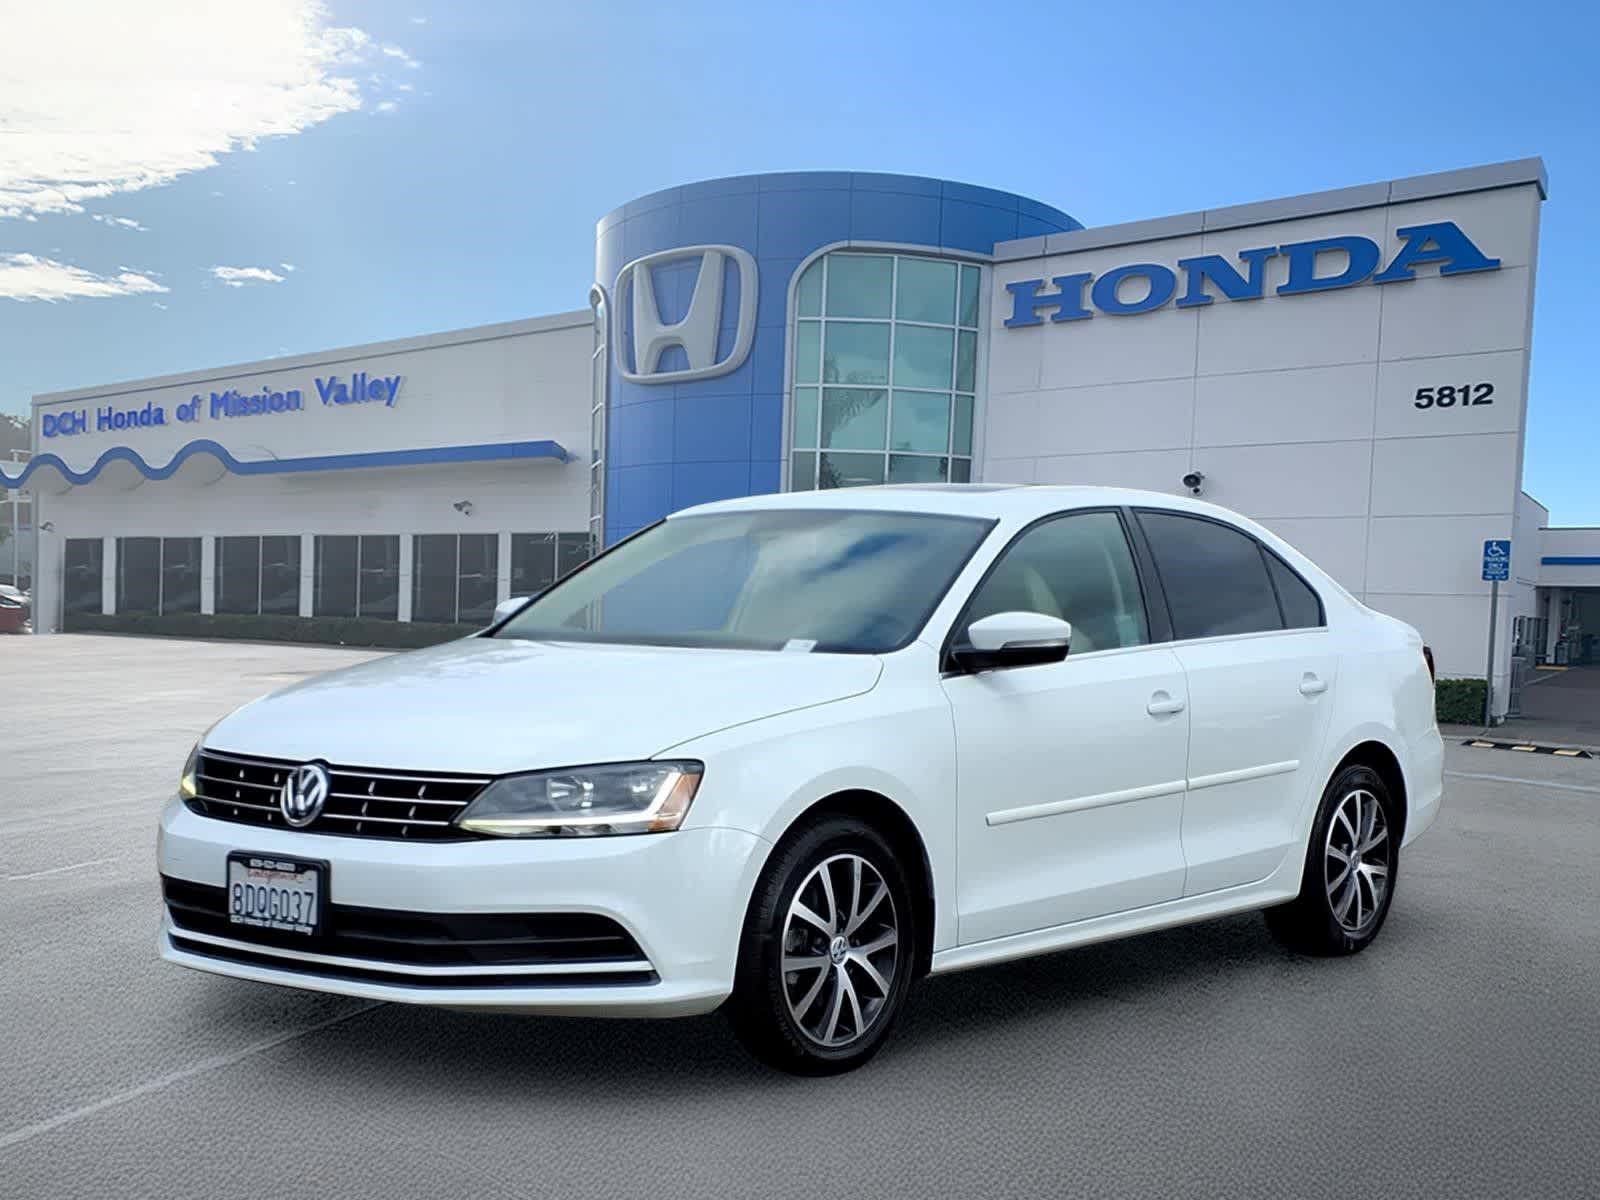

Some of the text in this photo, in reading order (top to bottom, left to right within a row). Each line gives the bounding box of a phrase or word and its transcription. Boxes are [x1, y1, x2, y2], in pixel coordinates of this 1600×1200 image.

[1004, 221, 1501, 328] HONDA
[42, 373, 401, 438] DCH Honda of Mission Valley
[1414, 383, 1494, 409] 5812
